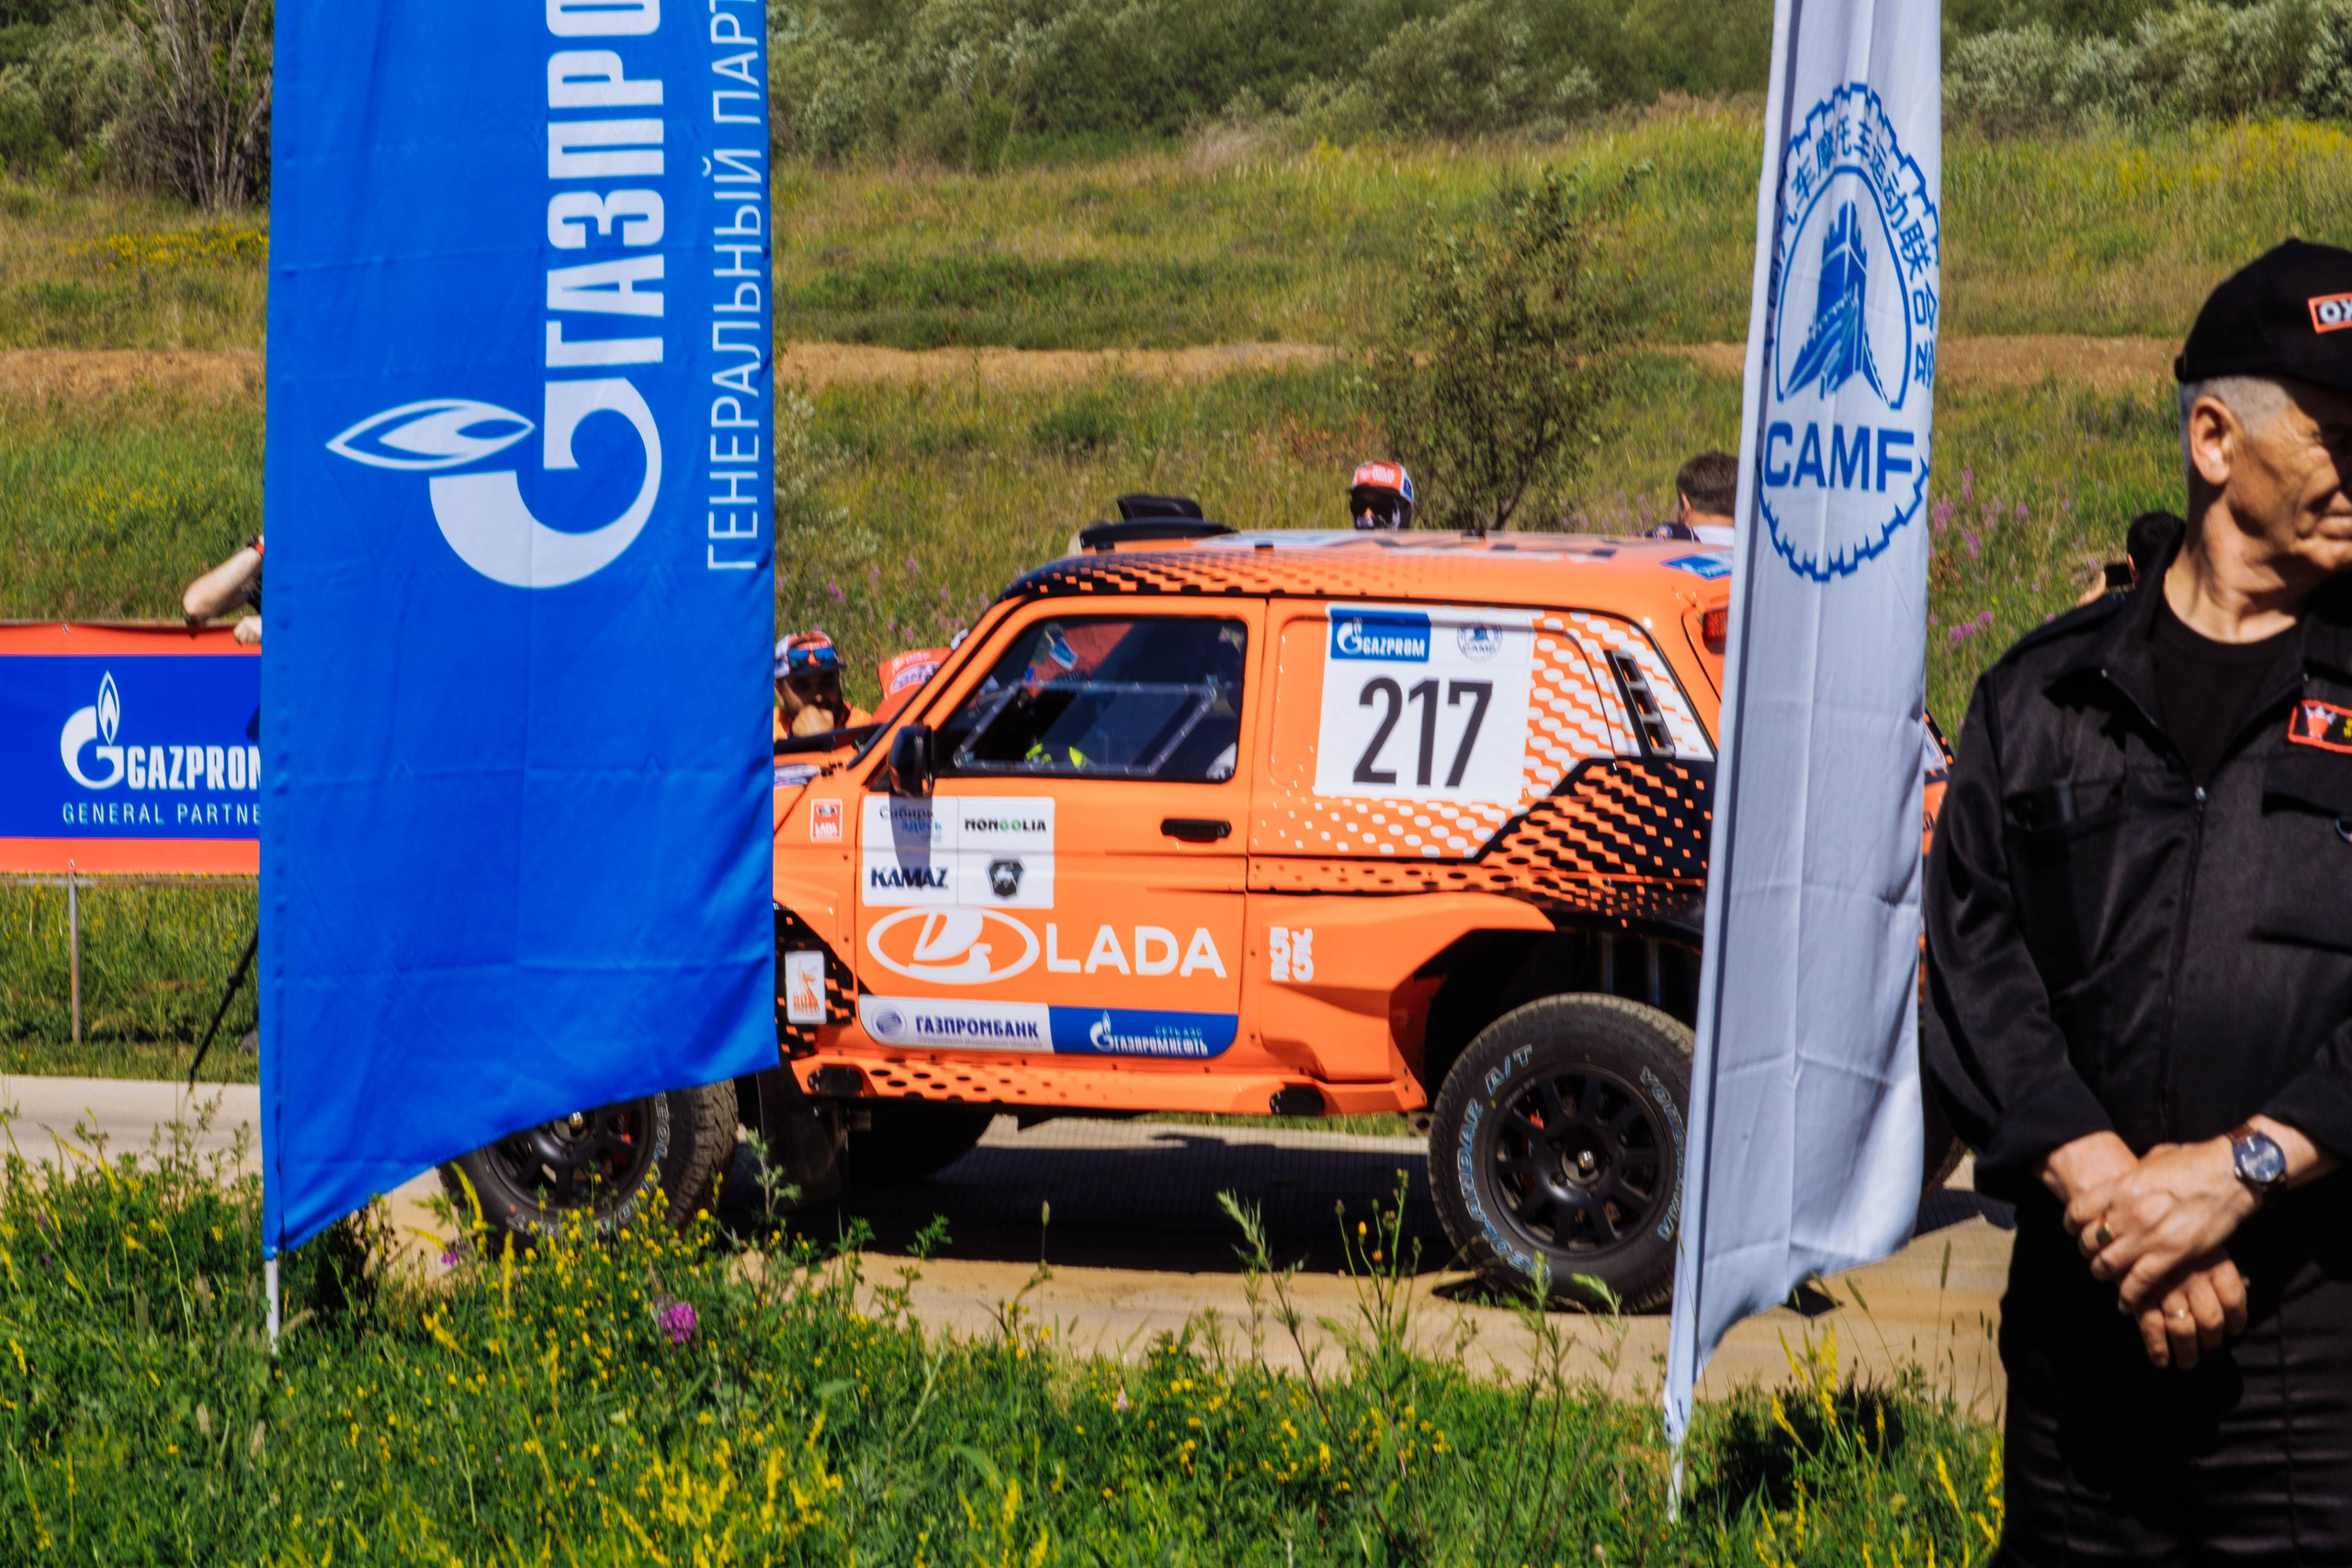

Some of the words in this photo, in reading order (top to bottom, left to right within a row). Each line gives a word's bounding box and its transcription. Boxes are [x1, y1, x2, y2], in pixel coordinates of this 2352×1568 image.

[702, 149, 762, 570] ГЕНЕРАЛЬНЫЙ
[1763, 420, 1915, 492] CAMF
[1363, 636, 1426, 658] GAZPROM
[1352, 673, 1494, 789] 217
[62, 801, 165, 825] GENERAL
[869, 866, 950, 891] KAMAZ
[1046, 922, 1227, 978] LADA
[915, 1015, 1040, 1039] ГАЗПРОМБАНК
[1114, 1035, 1209, 1056] ГАЗПРОМНЕФТЬ
[1484, 1043, 1532, 1097] A/T
